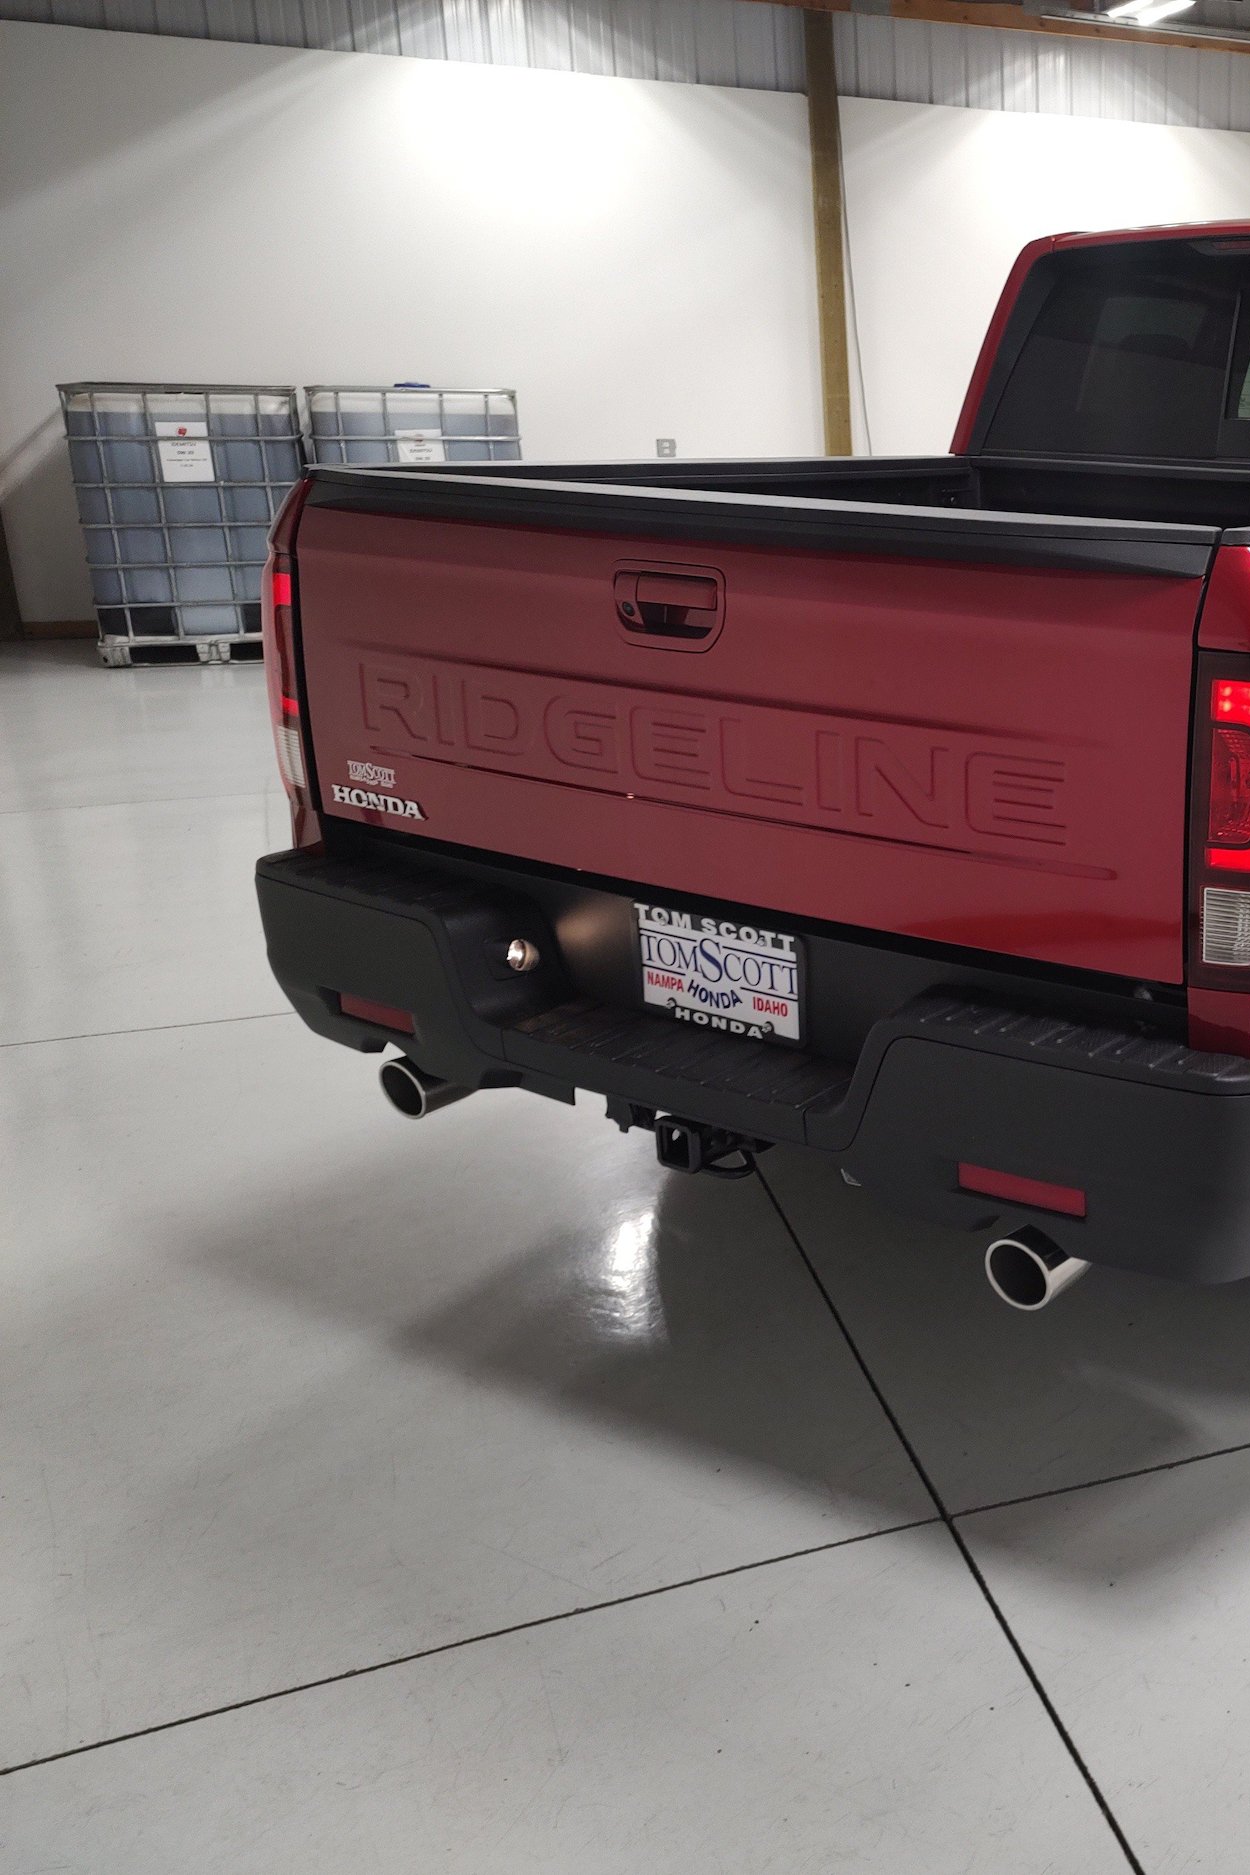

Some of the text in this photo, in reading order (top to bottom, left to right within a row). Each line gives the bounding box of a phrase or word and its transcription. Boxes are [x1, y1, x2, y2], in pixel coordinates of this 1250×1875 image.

[360, 662, 1067, 847] RIDGELINE
[331, 785, 425, 821] HONDA
[634, 903, 795, 953] TOM SCOTT
[647, 971, 684, 993] NAMPA
[687, 979, 743, 1010] HONDA
[752, 996, 788, 1017] IDAHO
[674, 1007, 764, 1040] HONDA
